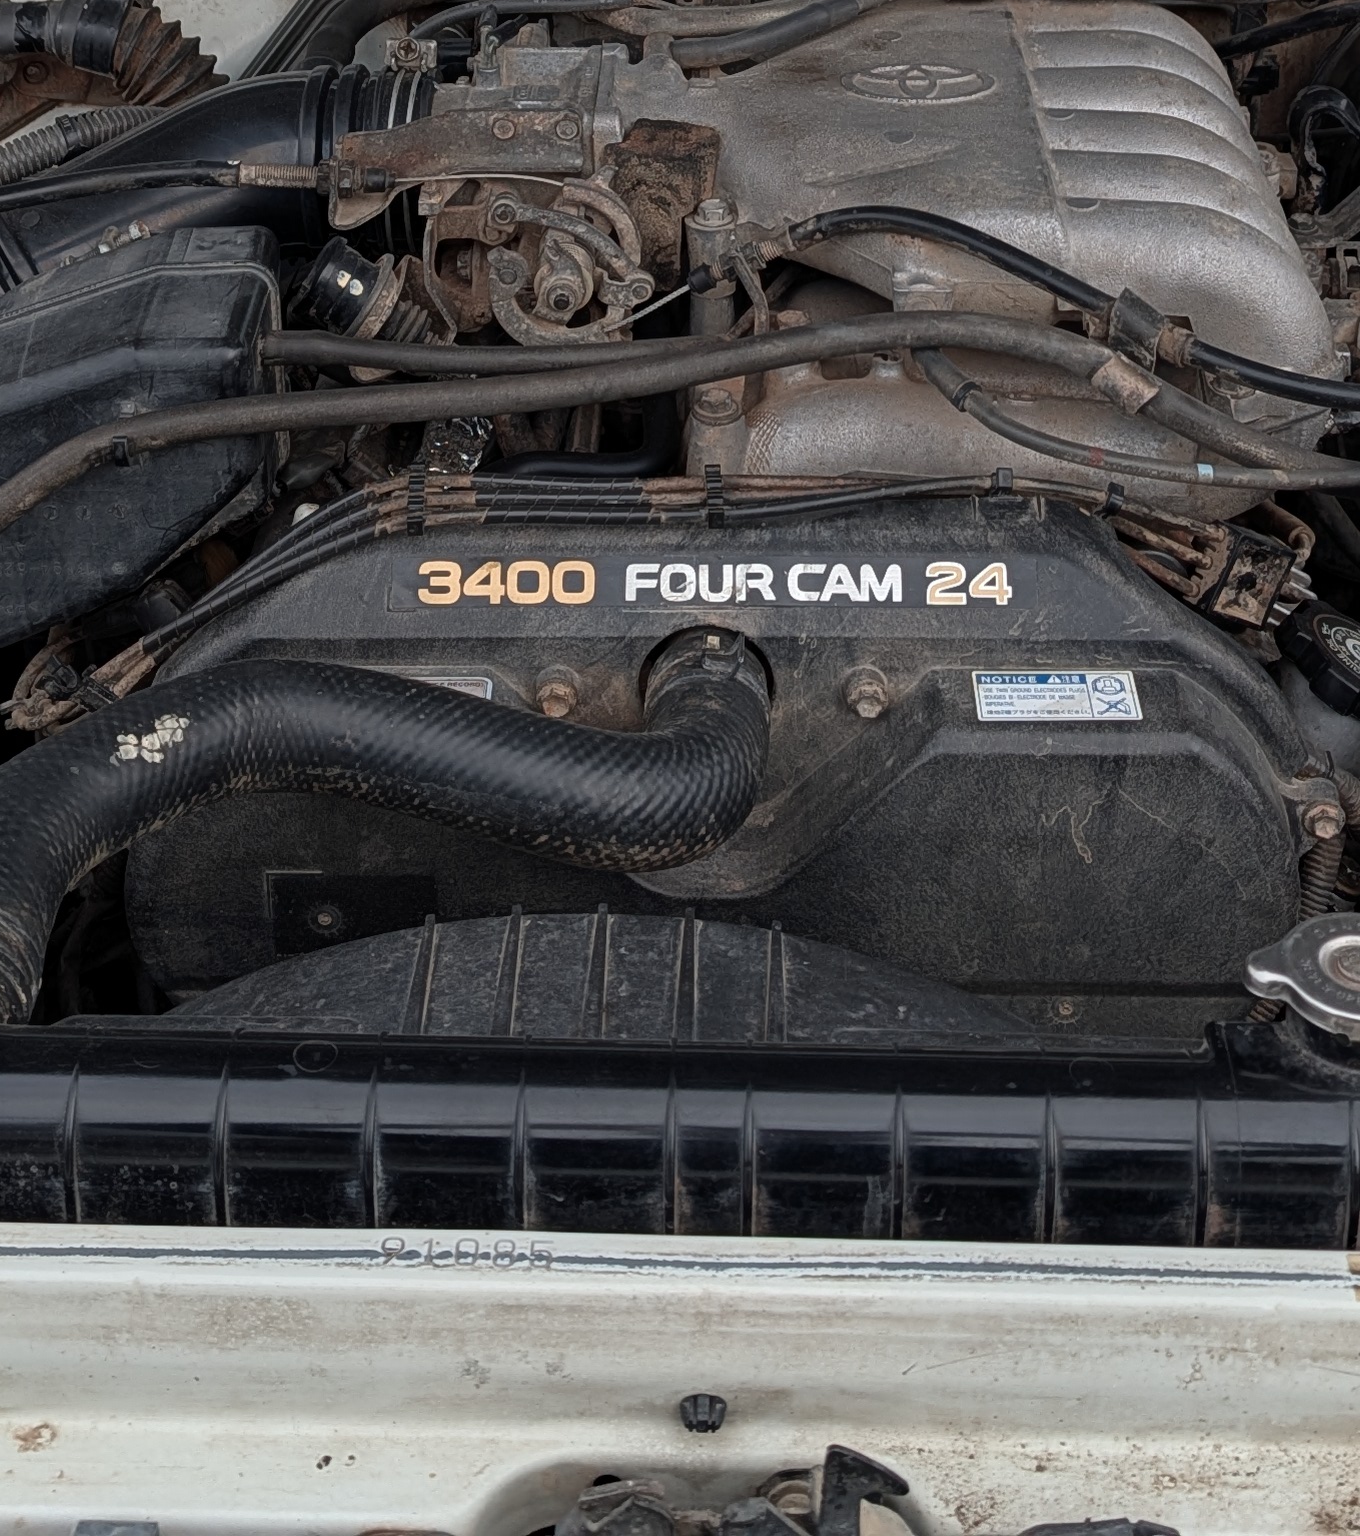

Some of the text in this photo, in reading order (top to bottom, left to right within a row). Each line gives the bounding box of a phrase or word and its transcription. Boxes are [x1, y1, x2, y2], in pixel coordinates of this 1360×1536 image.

[417, 560, 1014, 606] 3400 FOUR CAM 24
[980, 675, 1038, 684] NOTICE
[380, 1236, 554, 1268] 91085
